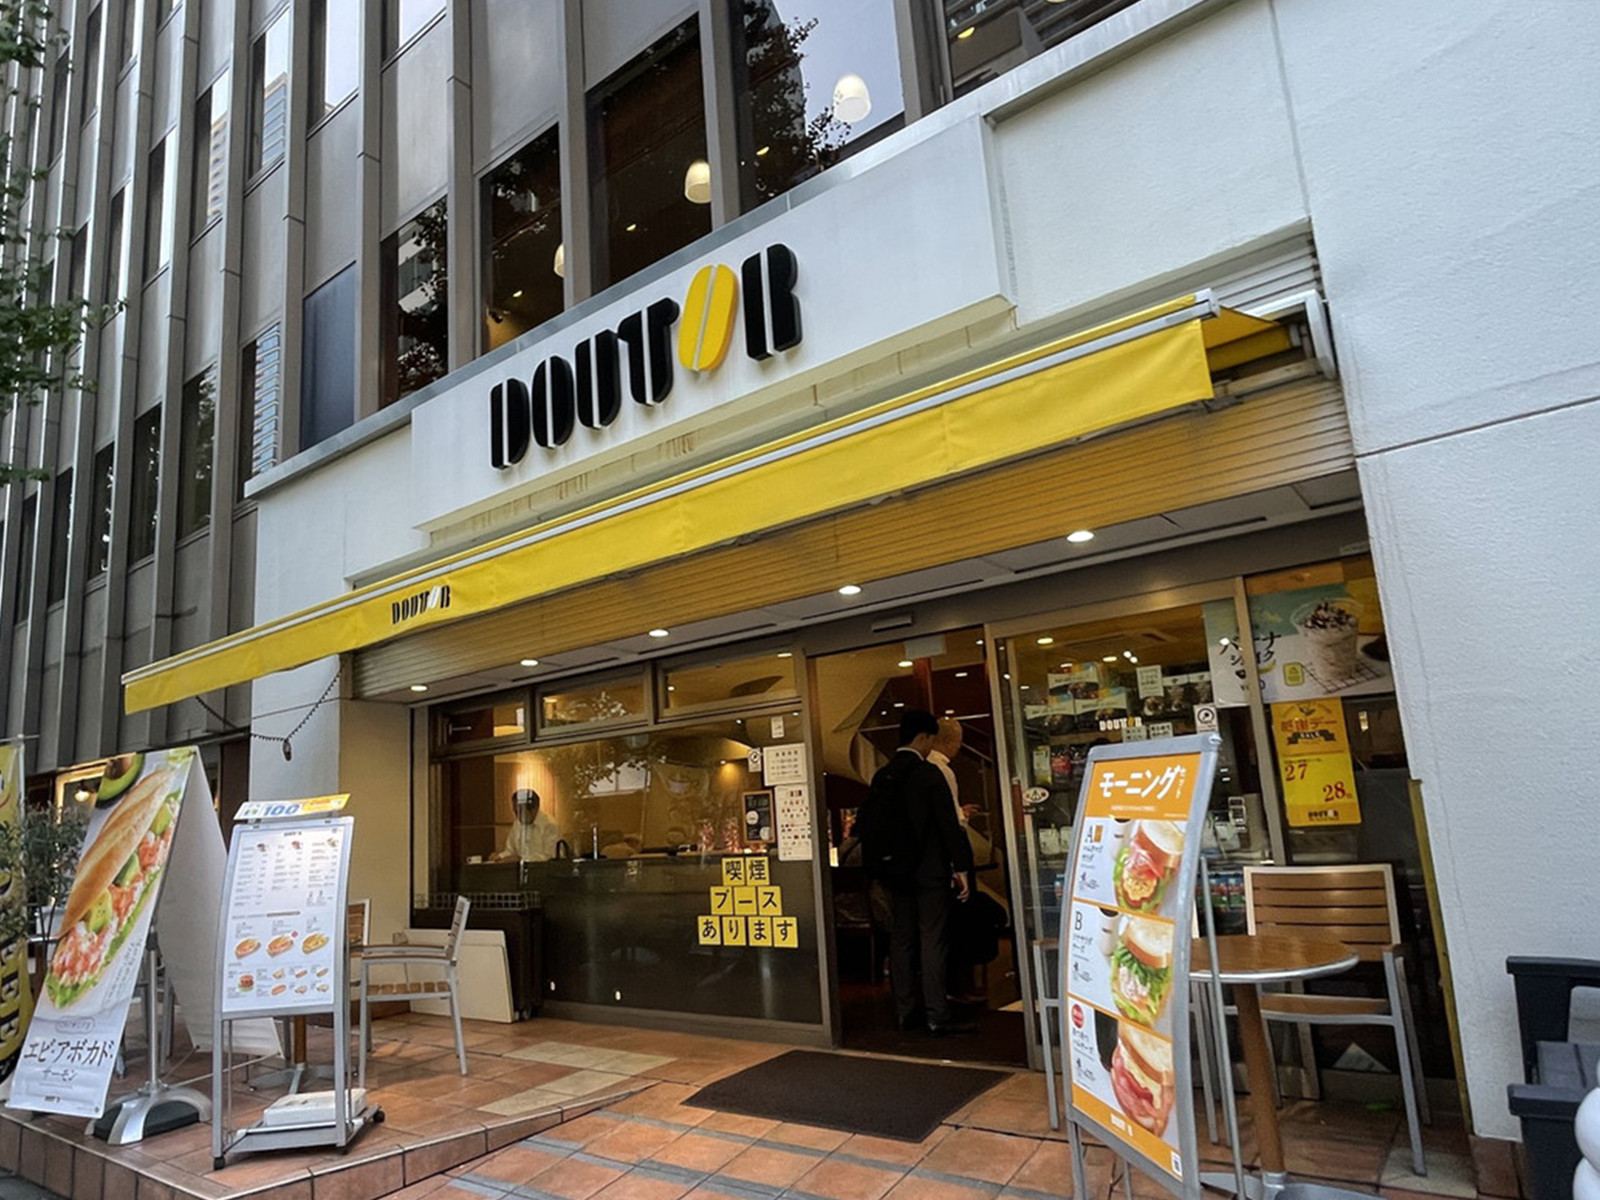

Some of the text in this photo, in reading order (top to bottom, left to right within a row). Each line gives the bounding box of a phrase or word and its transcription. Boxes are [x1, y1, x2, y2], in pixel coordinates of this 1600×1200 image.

[491, 243, 803, 469] DOUTOR
[392, 585, 450, 624] DOUTOR
[1099, 717, 1142, 732] DOUTOR
[1099, 764, 1182, 800] モーニング
[1285, 763, 1308, 782] 27
[1323, 781, 1347, 802] 28
[264, 803, 301, 817] 100
[726, 859, 766, 882] 喫煙
[714, 889, 778, 910] ブース
[701, 919, 793, 940] あります
[1074, 911, 1084, 931] B
